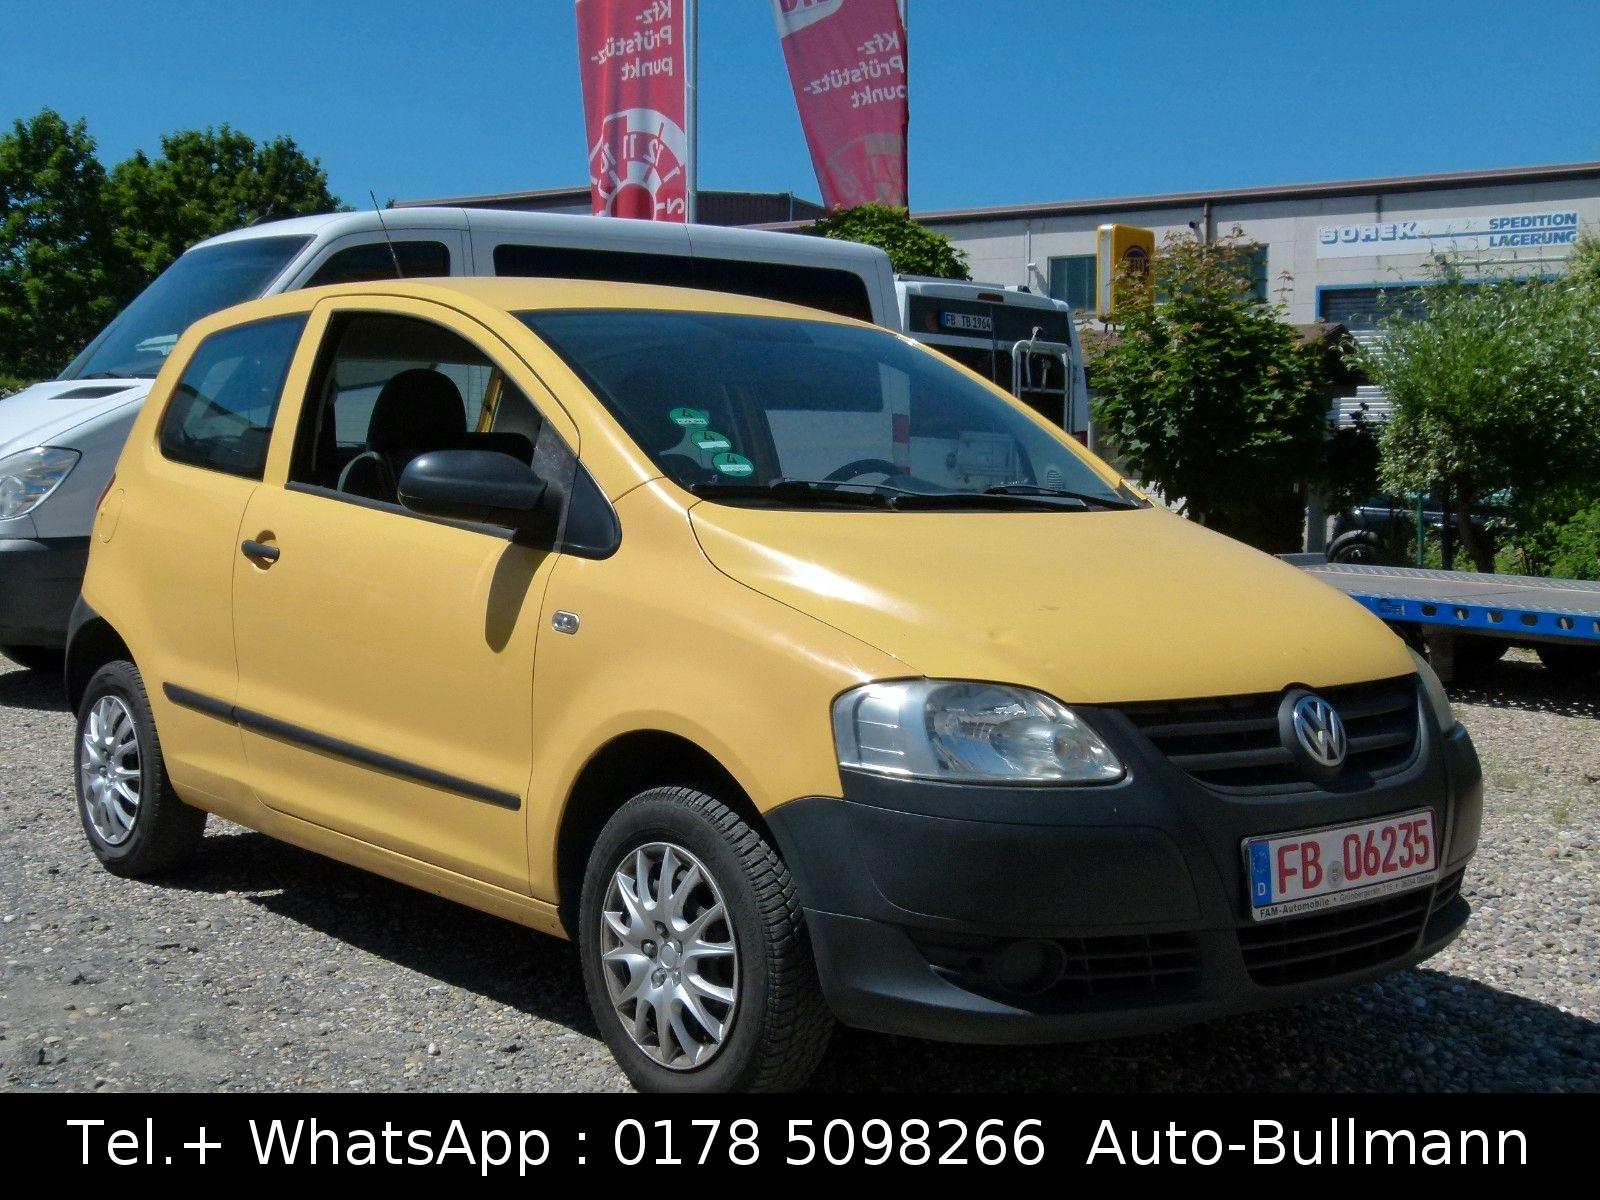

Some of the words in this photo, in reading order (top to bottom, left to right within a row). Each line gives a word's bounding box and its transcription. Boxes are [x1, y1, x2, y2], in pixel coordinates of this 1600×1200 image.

[1489, 212, 1578, 230] SPEDITION
[1489, 230, 1577, 248] LAGERUNG
[945, 312, 957, 328] FB
[962, 314, 972, 329] TB
[973, 316, 992, 330] 1964
[1277, 840, 1323, 895] FB
[1343, 819, 1430, 881] 06235
[1257, 882, 1266, 896] D
[1259, 898, 1330, 918] FAM-Automobile
